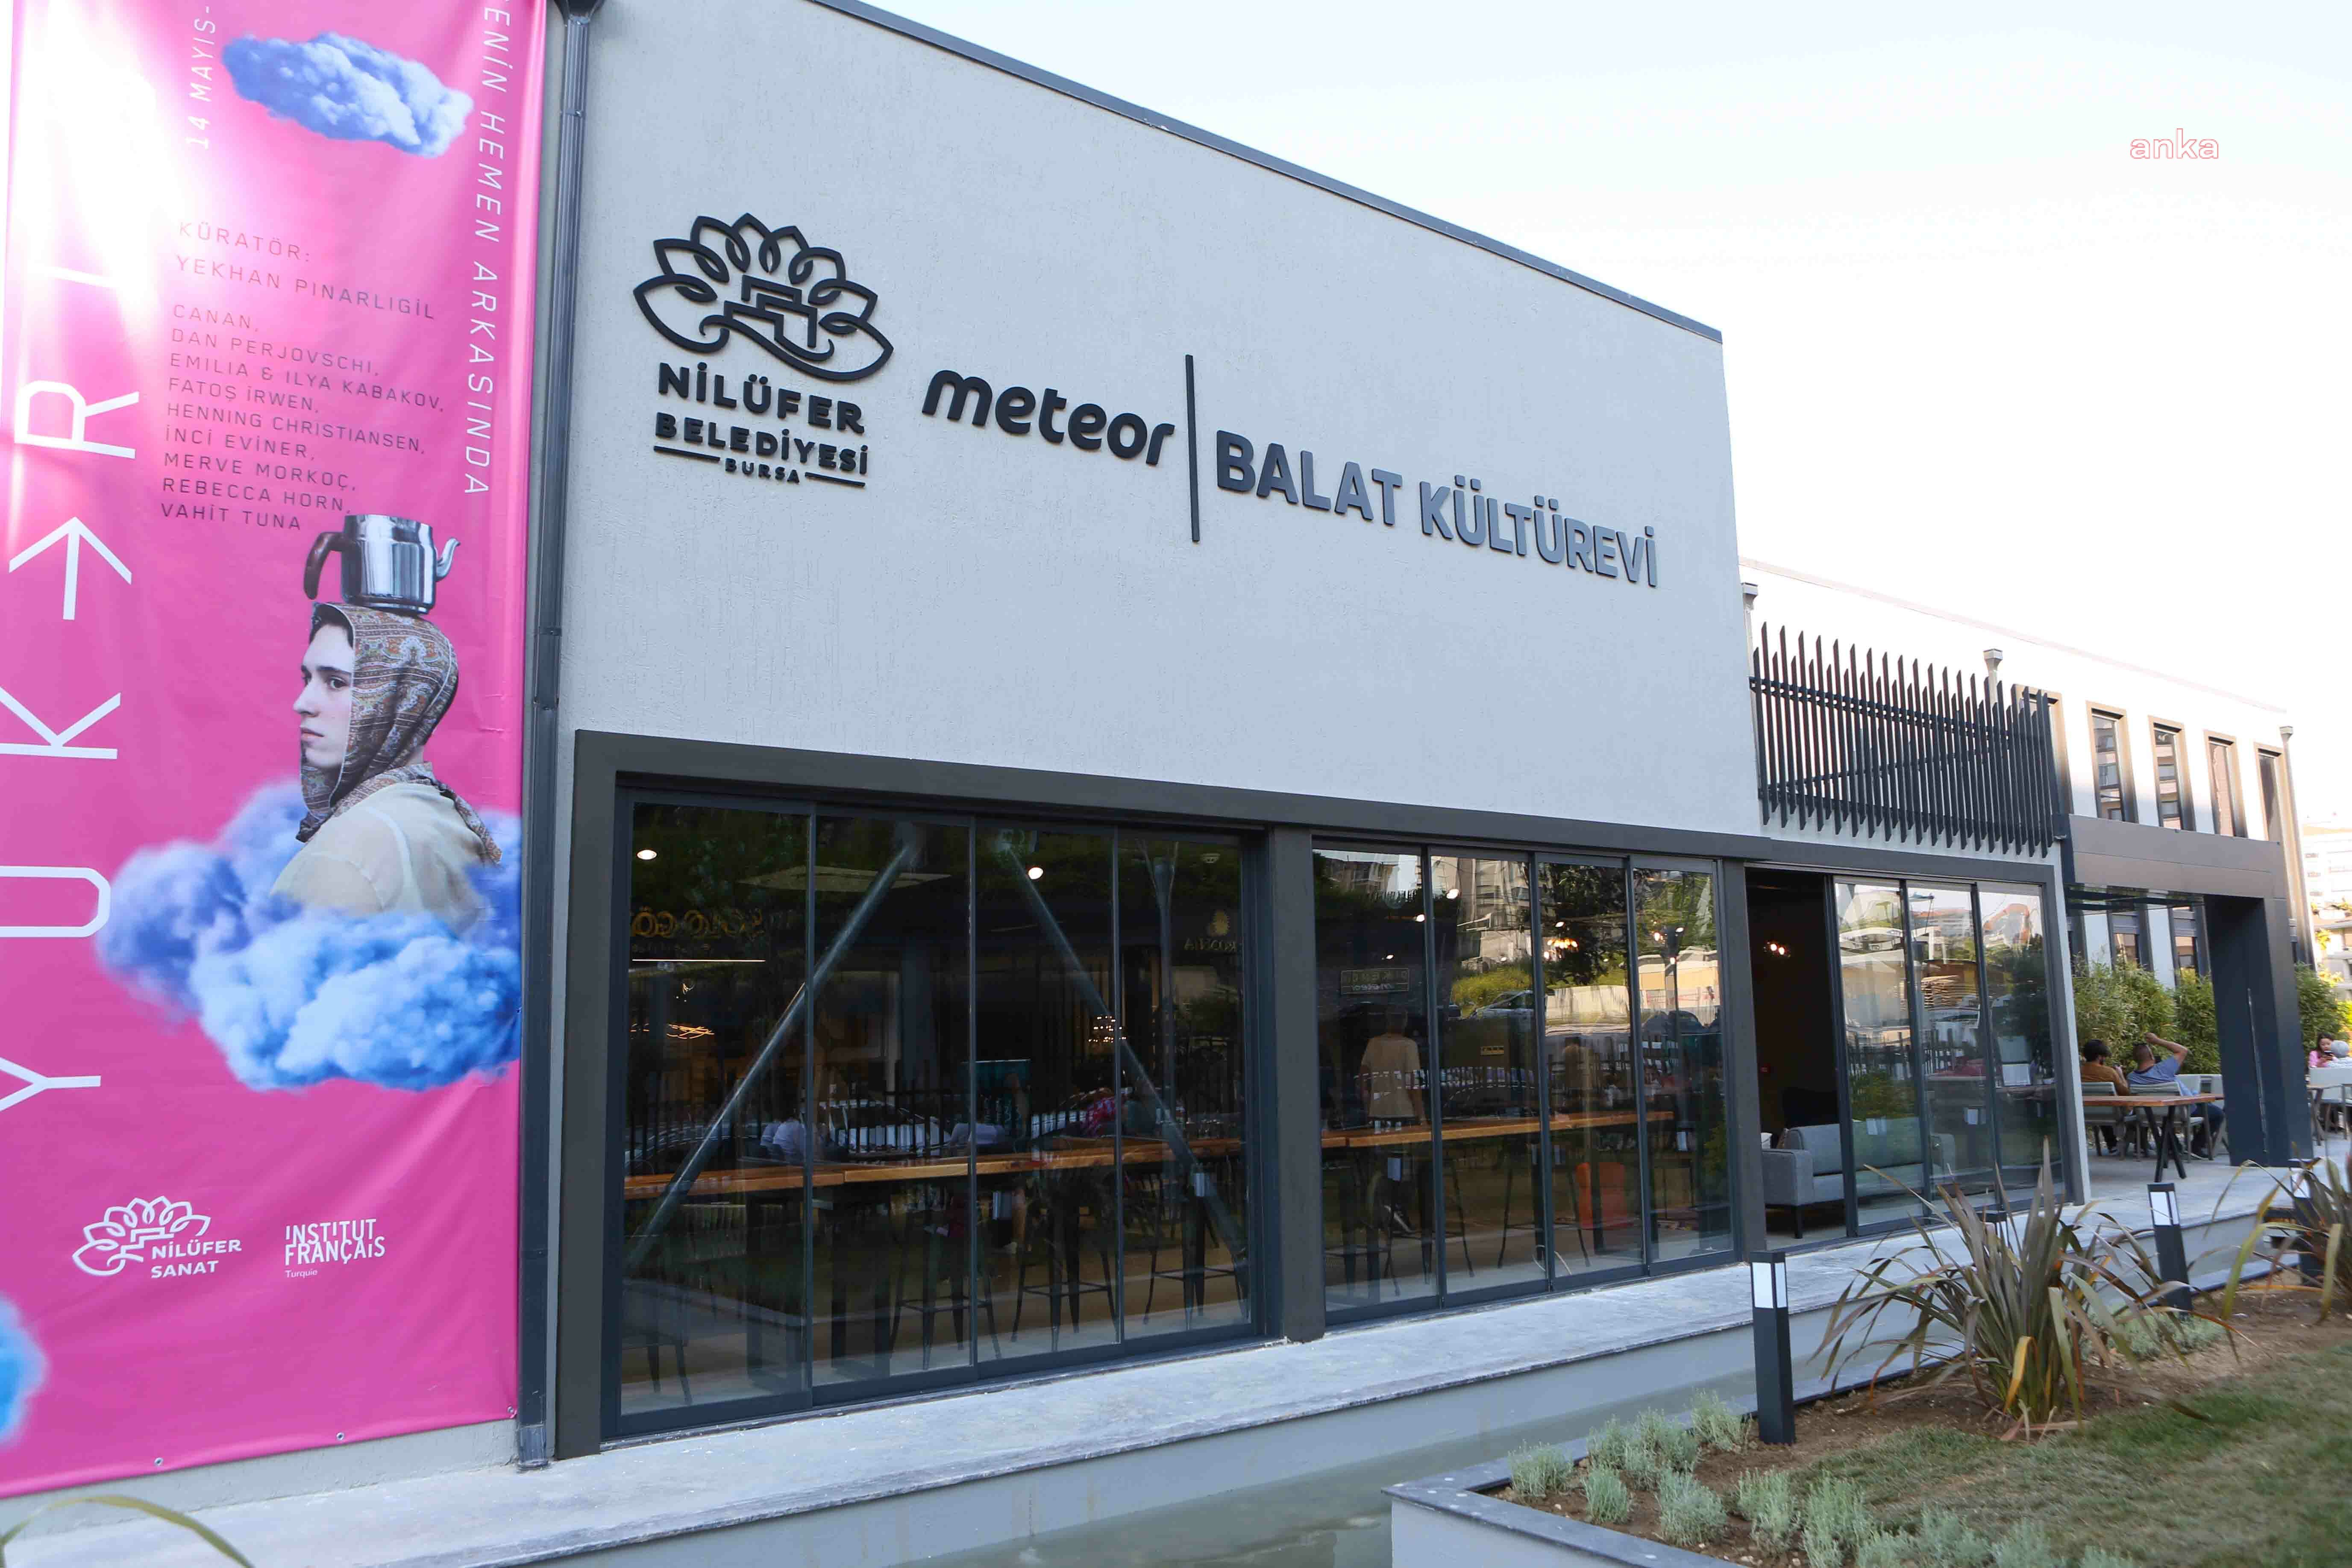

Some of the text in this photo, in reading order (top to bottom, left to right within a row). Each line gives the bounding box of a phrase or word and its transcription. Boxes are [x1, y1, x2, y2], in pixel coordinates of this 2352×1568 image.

[179, 221, 310, 262] KÜRATÖR:
[464, 0, 513, 494] ENİN HEMEN ARKASINDA
[176, 255, 435, 319] YEKHAN PINARLIGİL
[173, 304, 258, 332] CANAN,
[172, 329, 379, 376] DAN PERJOVSCHI,
[169, 378, 319, 413] FATOŞ İRWEN,
[170, 353, 443, 412] EMILIA & ILYA KABAKOV,
[658, 362, 865, 435] NİLÜFER
[167, 403, 424, 454] HENNING CHRISTIANSEN,
[922, 370, 1175, 466] meteor
[165, 425, 315, 461] İNCİ EVİNER,
[655, 412, 868, 475] BELEDİYESİ
[164, 454, 356, 491] MERVE MORKOÇ,
[725, 458, 800, 483] BURSA
[163, 478, 350, 514] REBECCA HORN,
[1216, 429, 1657, 587] BALAT KÜLTÜREVİ
[161, 503, 301, 530] VAHİT TUNA
[152, 1239, 242, 1260] NİLÜFER
[285, 1219, 376, 1248] INSTITUT
[285, 1236, 385, 1266] FRANÇAIS
[151, 1260, 218, 1278] SANAT
